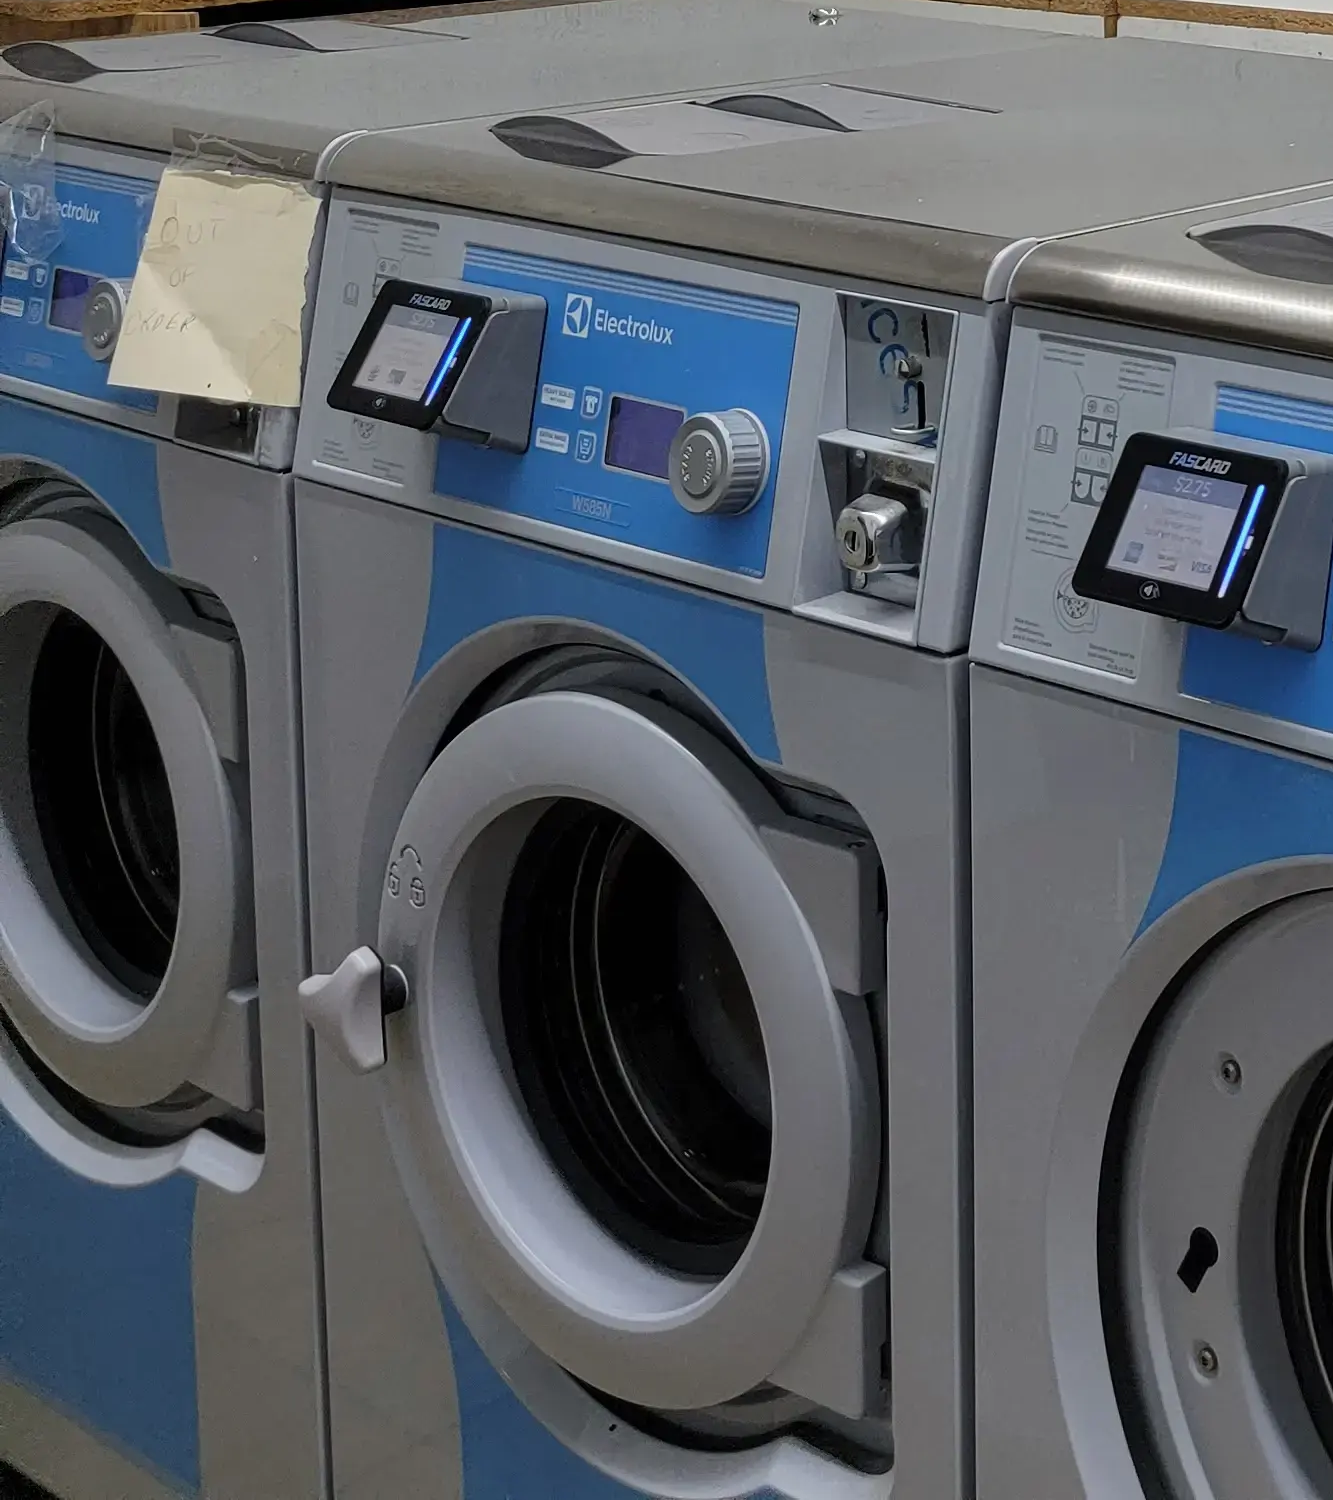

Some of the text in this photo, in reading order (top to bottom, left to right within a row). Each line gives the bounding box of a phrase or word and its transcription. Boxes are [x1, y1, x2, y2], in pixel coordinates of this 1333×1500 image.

[161, 216, 225, 245] OUT
[169, 263, 197, 287] OF
[409, 293, 452, 311] FASCARD
[594, 308, 674, 345] Electrolux
[1169, 452, 1231, 475] FASCARD
[572, 495, 612, 520] W585N
